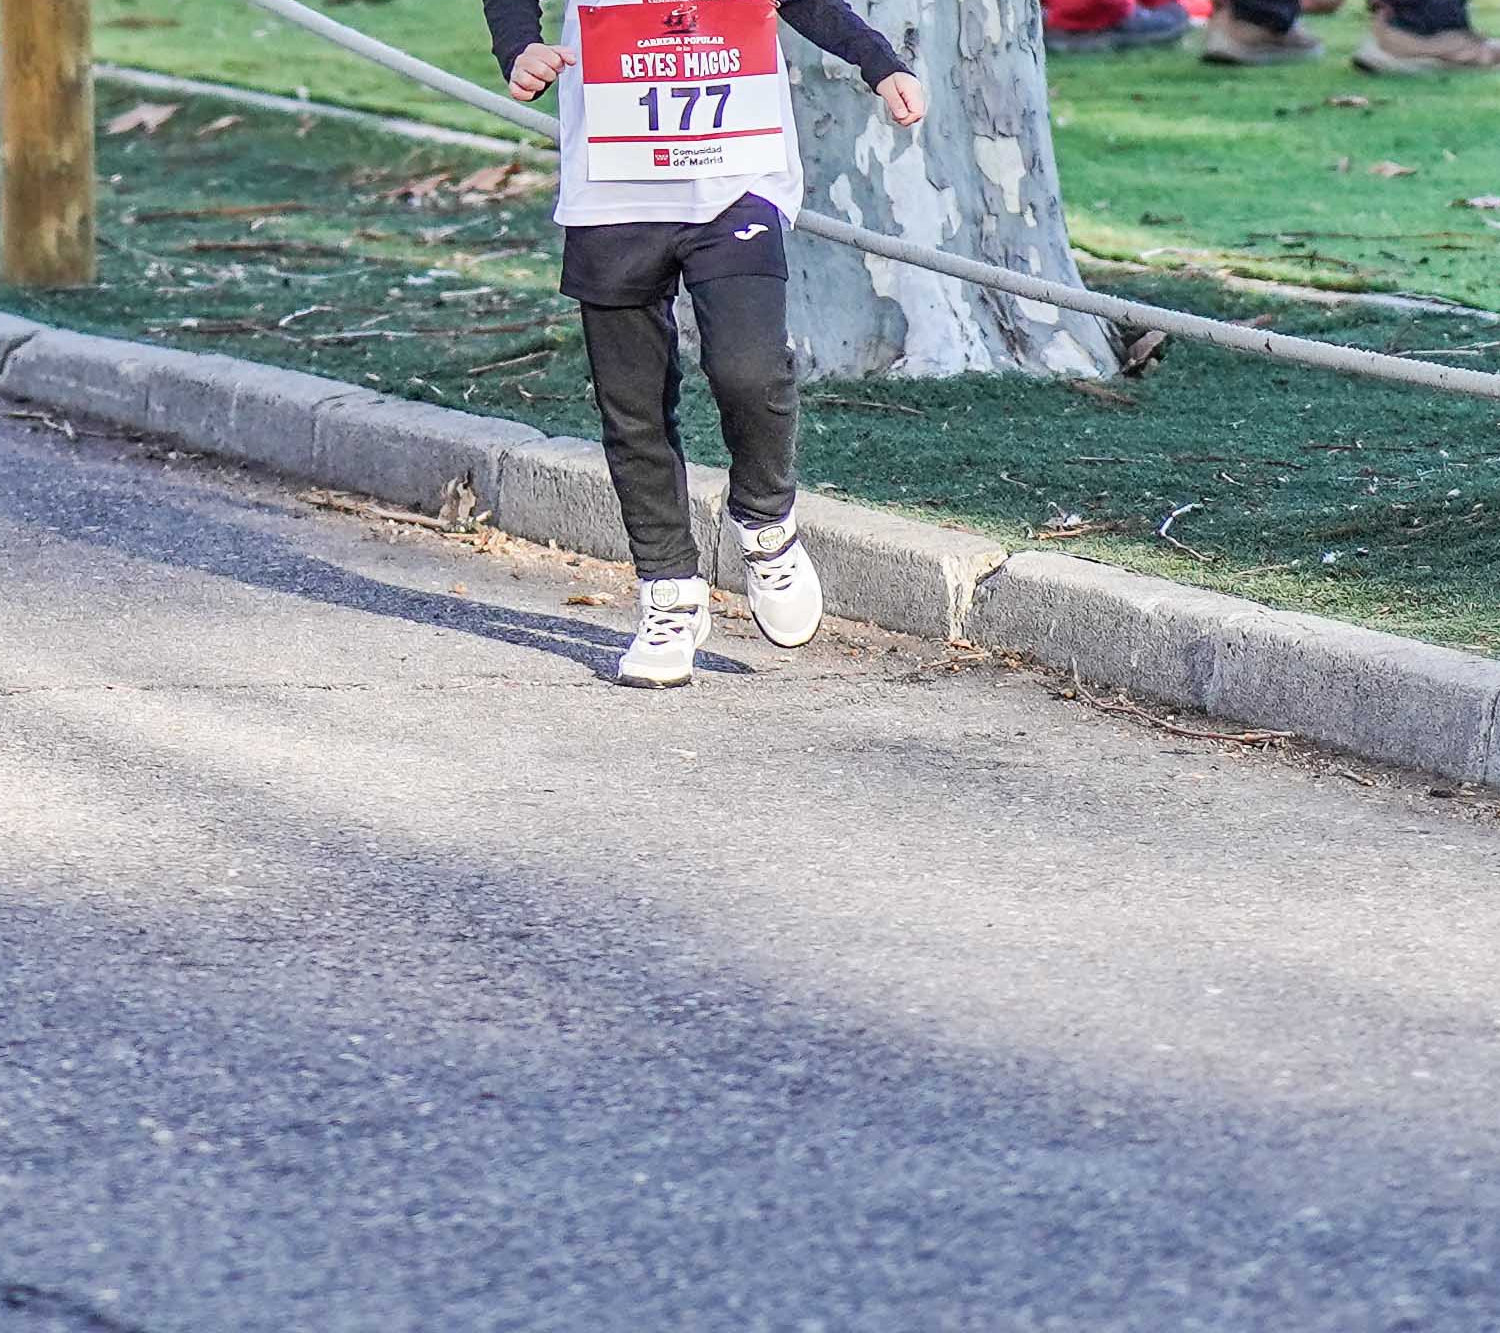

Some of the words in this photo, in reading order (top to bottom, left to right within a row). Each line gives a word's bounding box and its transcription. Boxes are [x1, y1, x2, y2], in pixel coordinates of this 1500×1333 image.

[637, 37, 682, 48] CARRERA
[684, 36, 724, 45] POPULAR
[620, 52, 677, 78] REYES
[683, 48, 741, 78] MAGOS
[639, 84, 731, 131] 177
[672, 146, 722, 156] Comunidad
[673, 157, 685, 167] de
[689, 156, 723, 166] Madrid
